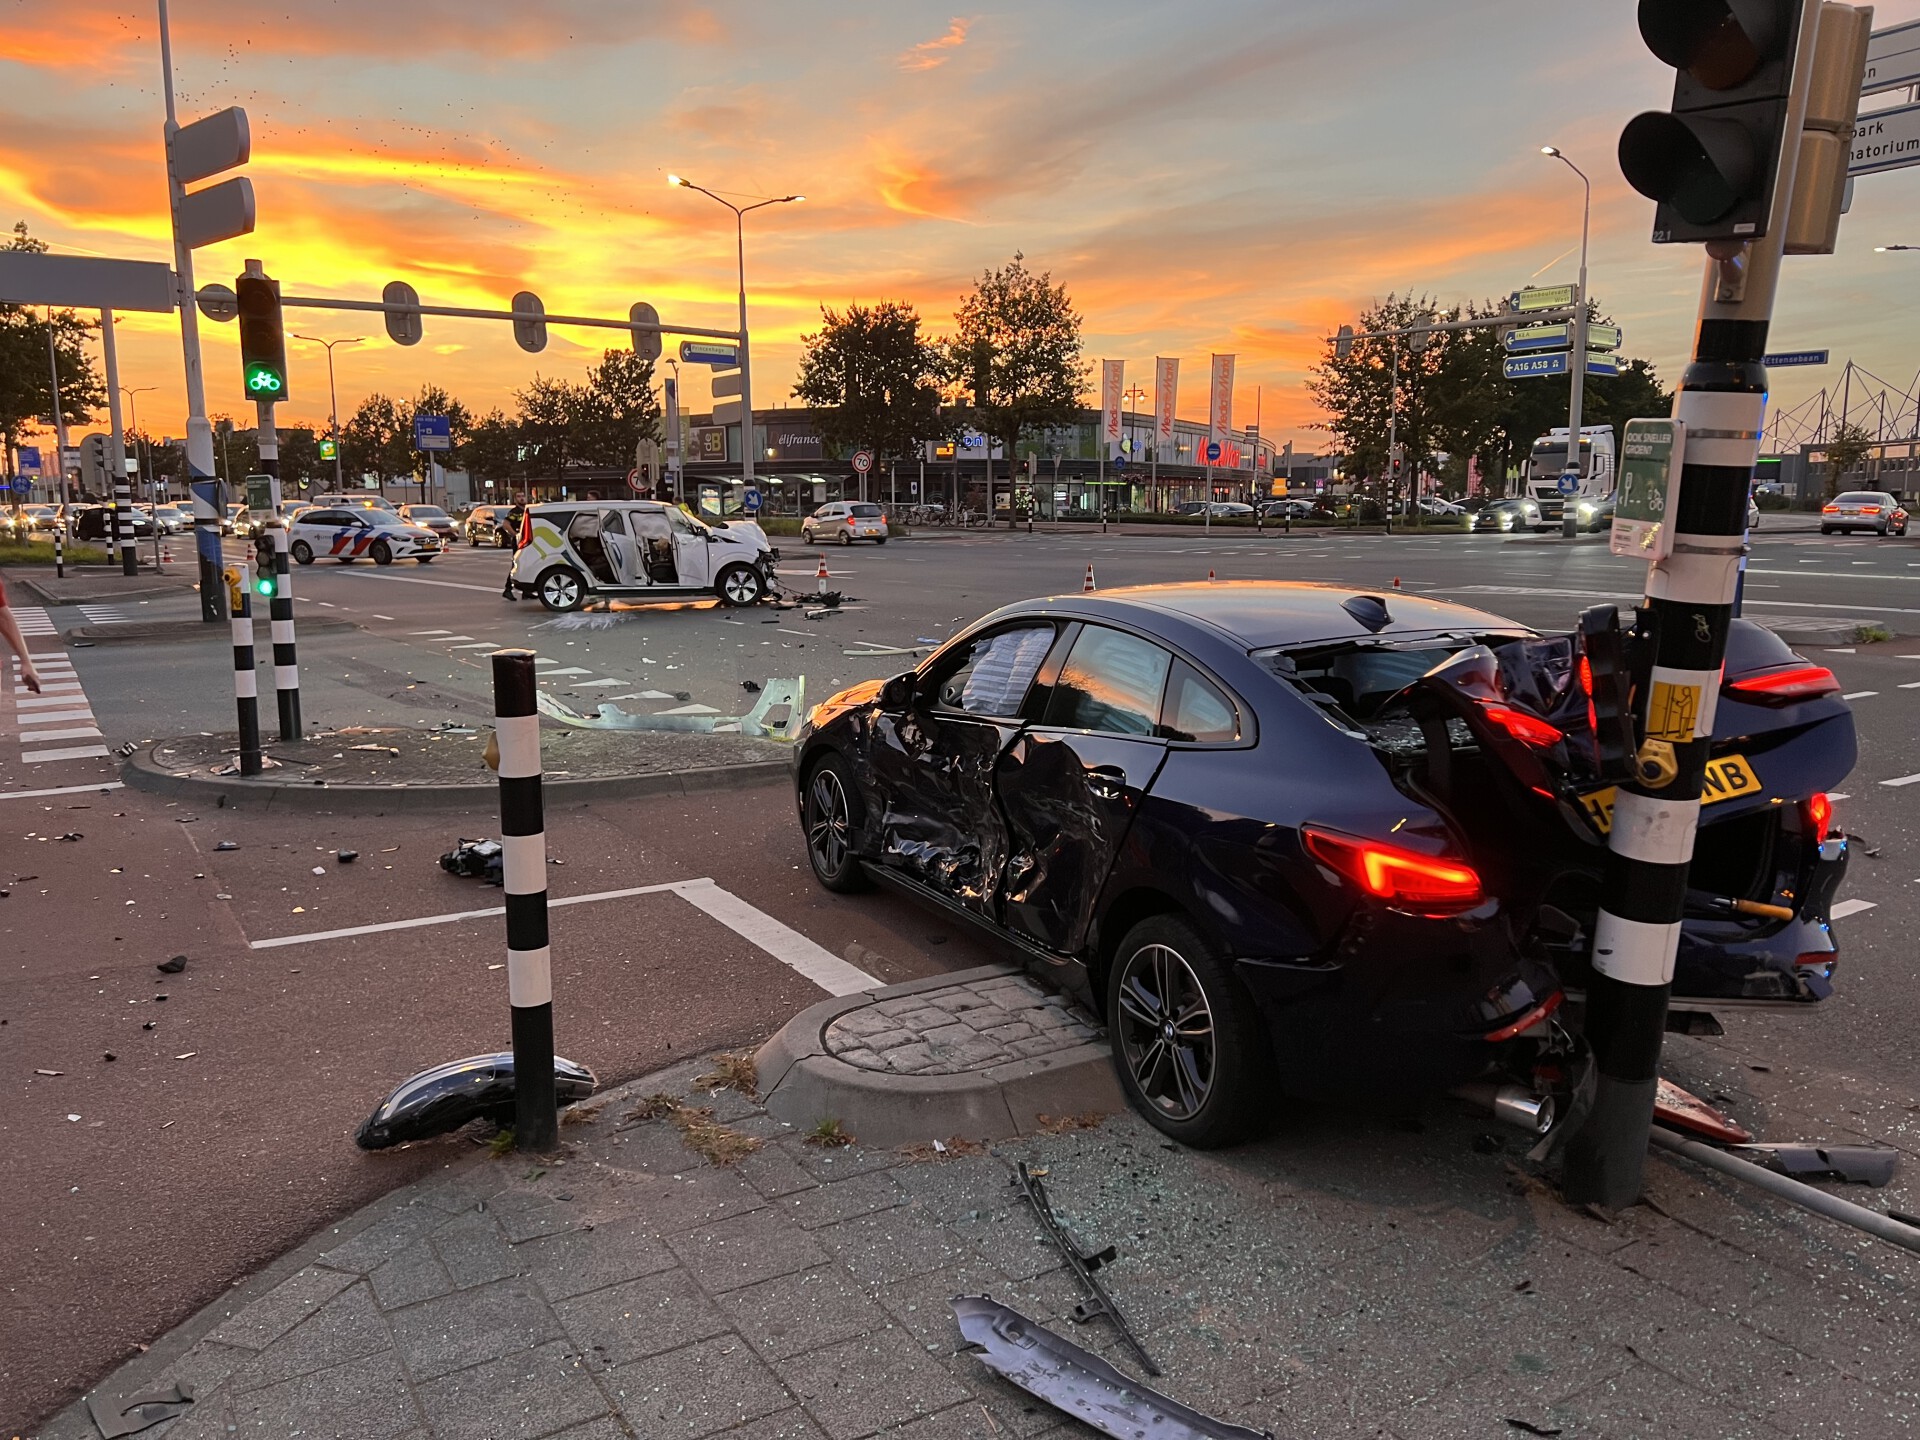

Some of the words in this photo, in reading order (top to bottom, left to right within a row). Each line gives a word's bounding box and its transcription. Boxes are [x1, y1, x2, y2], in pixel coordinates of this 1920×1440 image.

[1516, 331, 1530, 339] IKEA
[1765, 354, 1819, 365] Ettensebaan
[1513, 362, 1529, 372] A16
[1531, 360, 1548, 370] A58
[1627, 432, 1642, 443] OOK
[1643, 433, 1672, 444] SNELLER
[1625, 444, 1653, 455] GROEN?
[857, 457, 869, 467] 70
